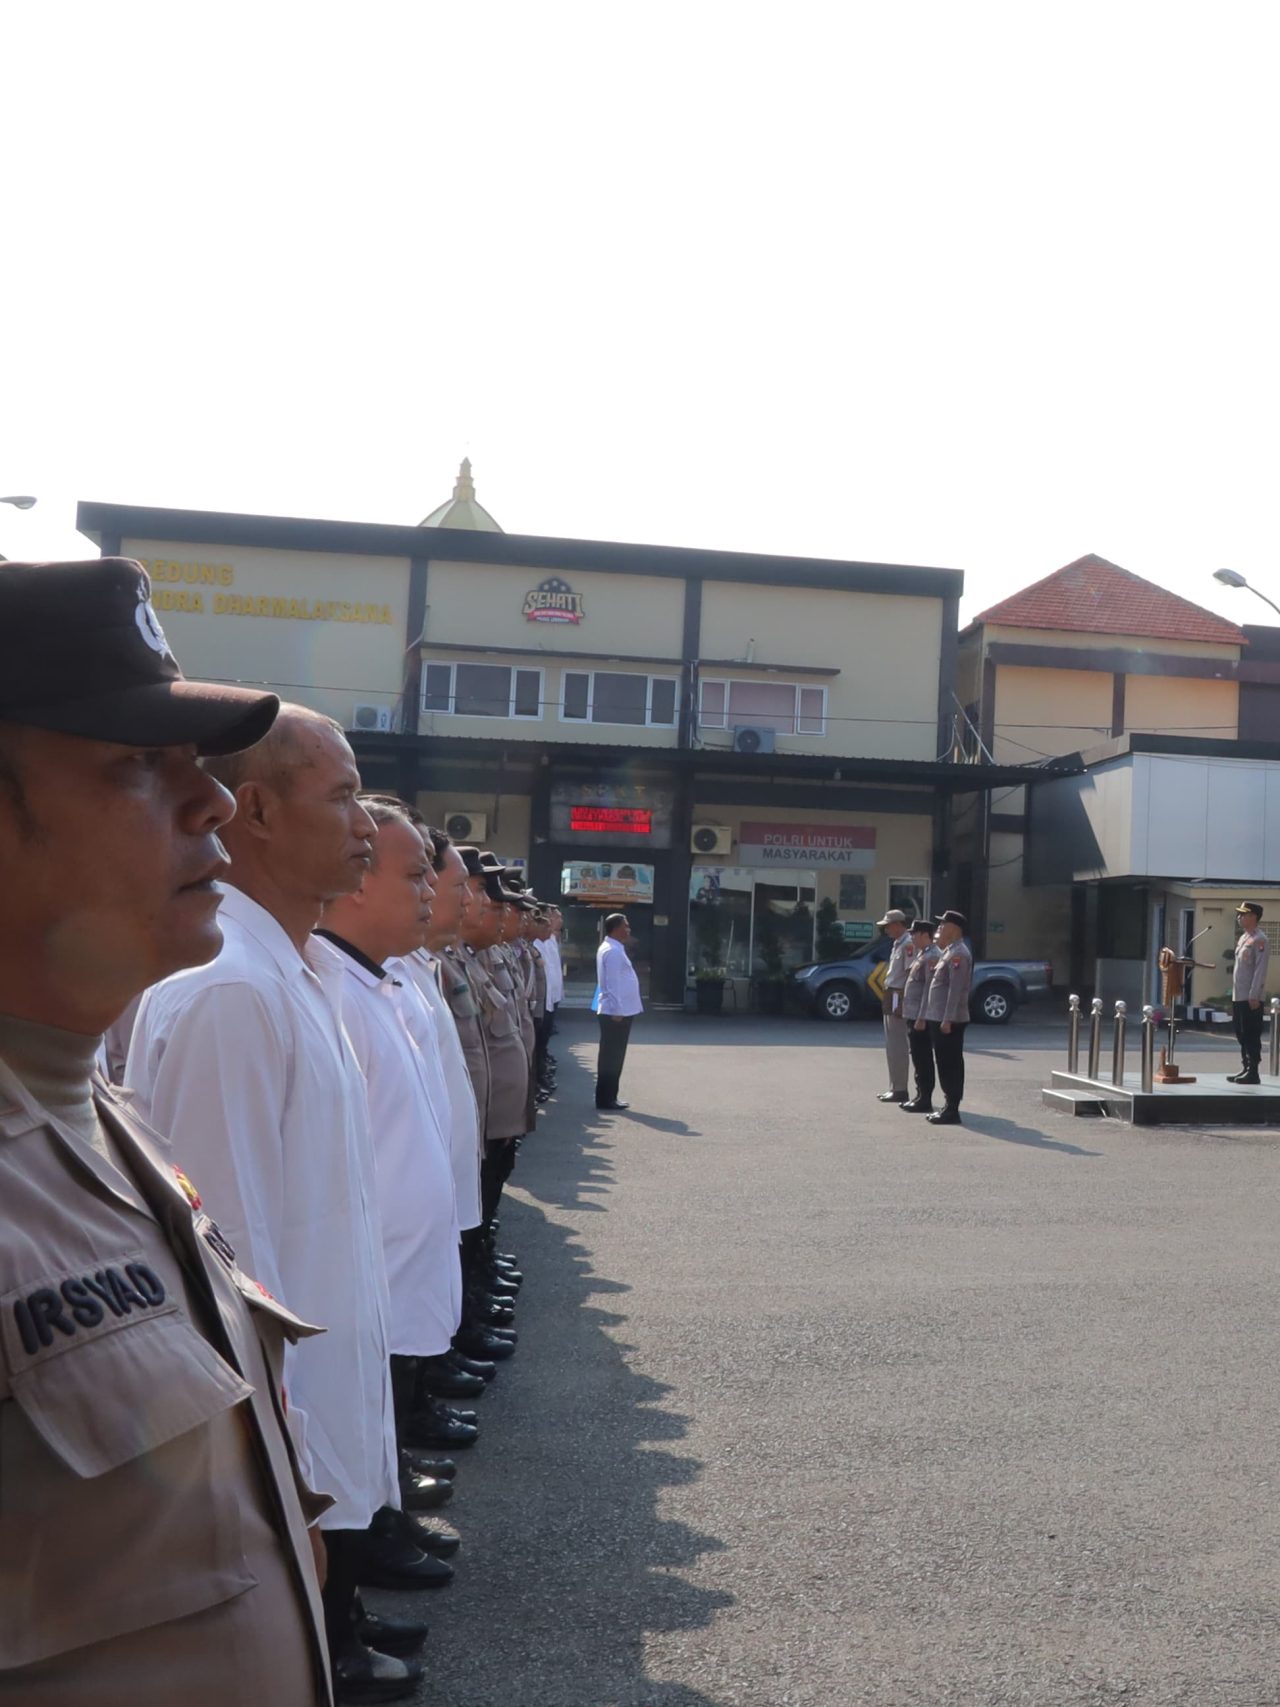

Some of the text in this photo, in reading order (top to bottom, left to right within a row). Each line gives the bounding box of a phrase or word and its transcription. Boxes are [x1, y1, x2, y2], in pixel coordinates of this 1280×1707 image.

[523, 592, 584, 616] SEHATI
[764, 834, 853, 848] POLRI UNTUK
[762, 848, 853, 862] MASYARAKAT
[14, 1263, 165, 1355] IRSYAD
